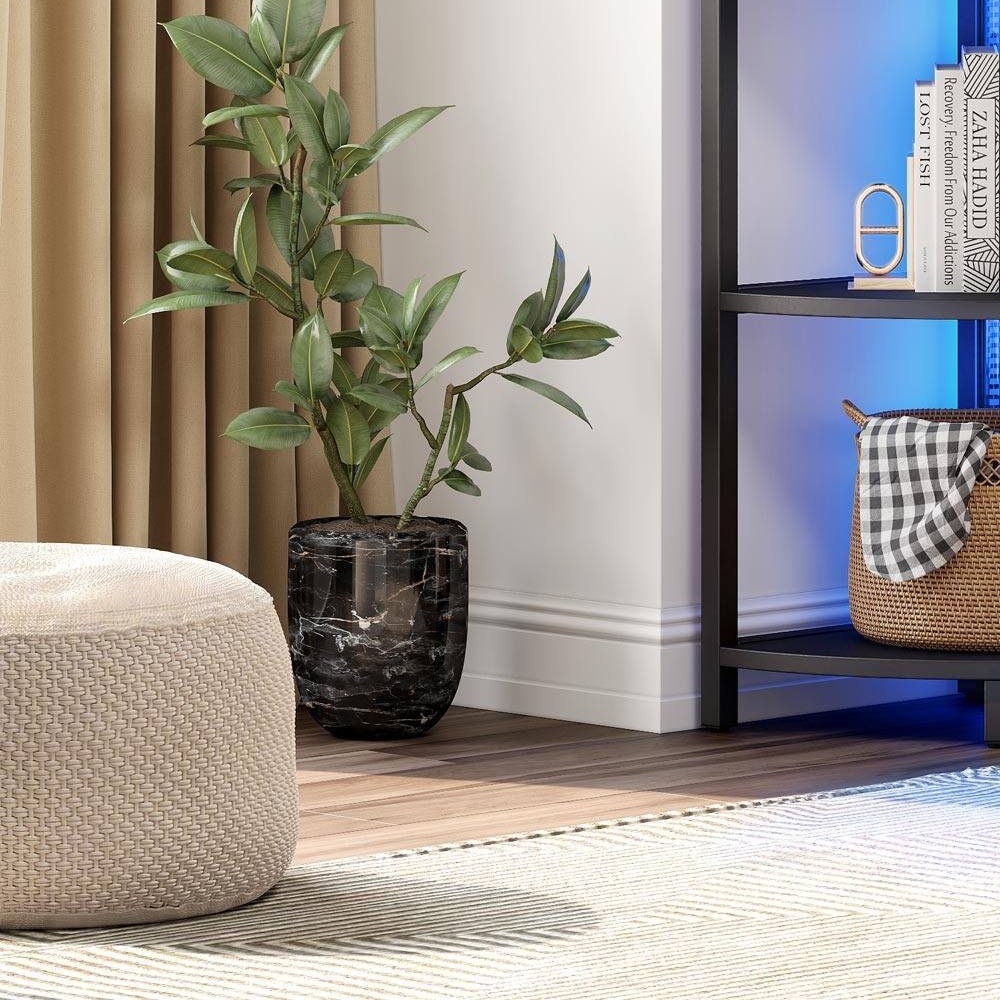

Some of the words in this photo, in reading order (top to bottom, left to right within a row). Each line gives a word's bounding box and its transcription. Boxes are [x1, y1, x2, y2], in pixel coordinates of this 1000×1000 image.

[919, 92, 931, 140] LOST
[938, 77, 958, 128] Recovery.
[943, 130, 958, 176] Freedom
[971, 110, 988, 163] ZAHA
[919, 145, 931, 187] FISH
[943, 178, 958, 206] From
[971, 167, 988, 230] HADID
[943, 207, 958, 229] Our
[943, 230, 959, 287] Addictions
